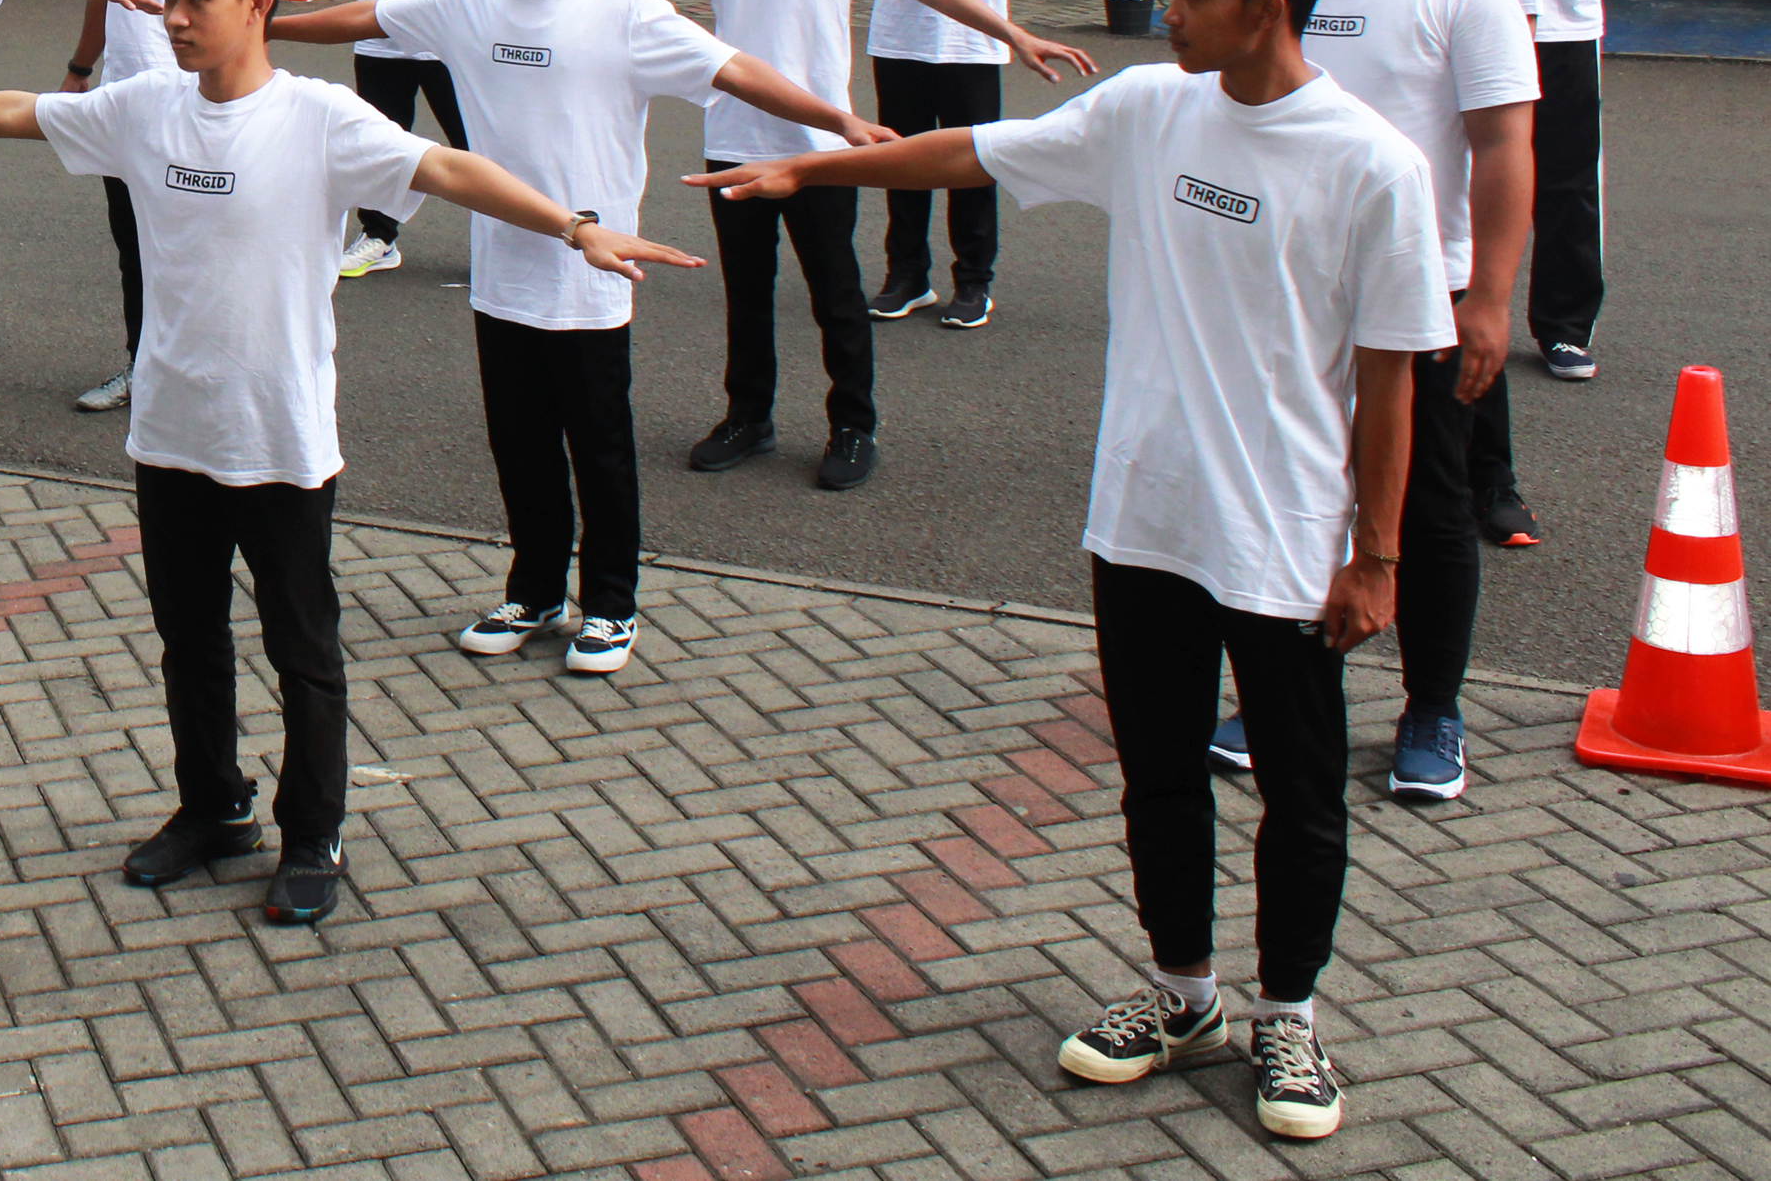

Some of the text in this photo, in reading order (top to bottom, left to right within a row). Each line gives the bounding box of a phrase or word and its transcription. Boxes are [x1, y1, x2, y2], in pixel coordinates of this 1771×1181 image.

[1307, 18, 1357, 32] HRGID
[500, 47, 544, 63] THRGID
[173, 170, 226, 190] THRGID
[1185, 182, 1248, 215] THRGID
